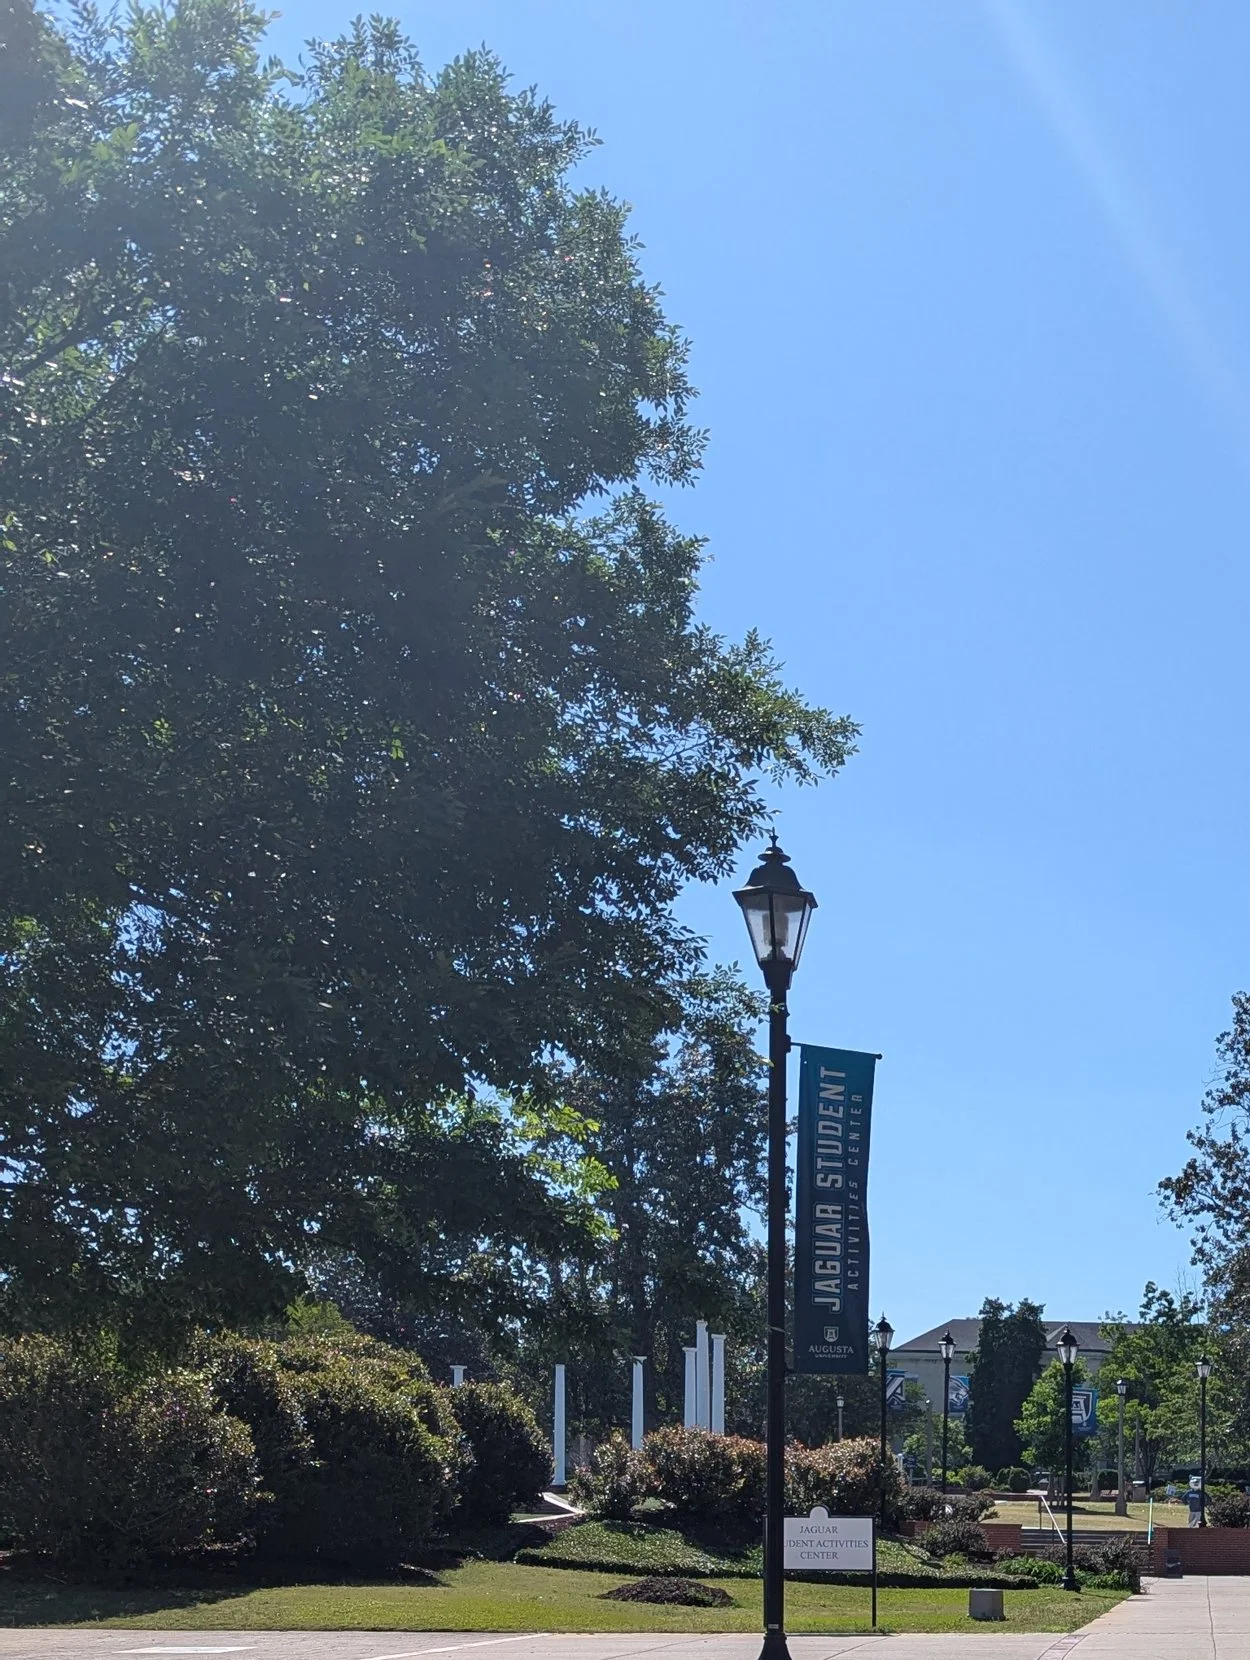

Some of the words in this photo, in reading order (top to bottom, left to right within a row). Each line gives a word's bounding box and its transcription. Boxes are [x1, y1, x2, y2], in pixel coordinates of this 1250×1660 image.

[816, 1066, 846, 1188] STUDENT
[848, 1094, 863, 1166] CENTER
[814, 1204, 842, 1311] JAGUAR
[847, 1181, 860, 1290] ACTIVITIES
[808, 1345, 854, 1354] AUGUSTA
[784, 1540, 815, 1548] UDENT
[816, 1540, 869, 1548] ACTIVITIES
[800, 1526, 838, 1534] JAGUAR
